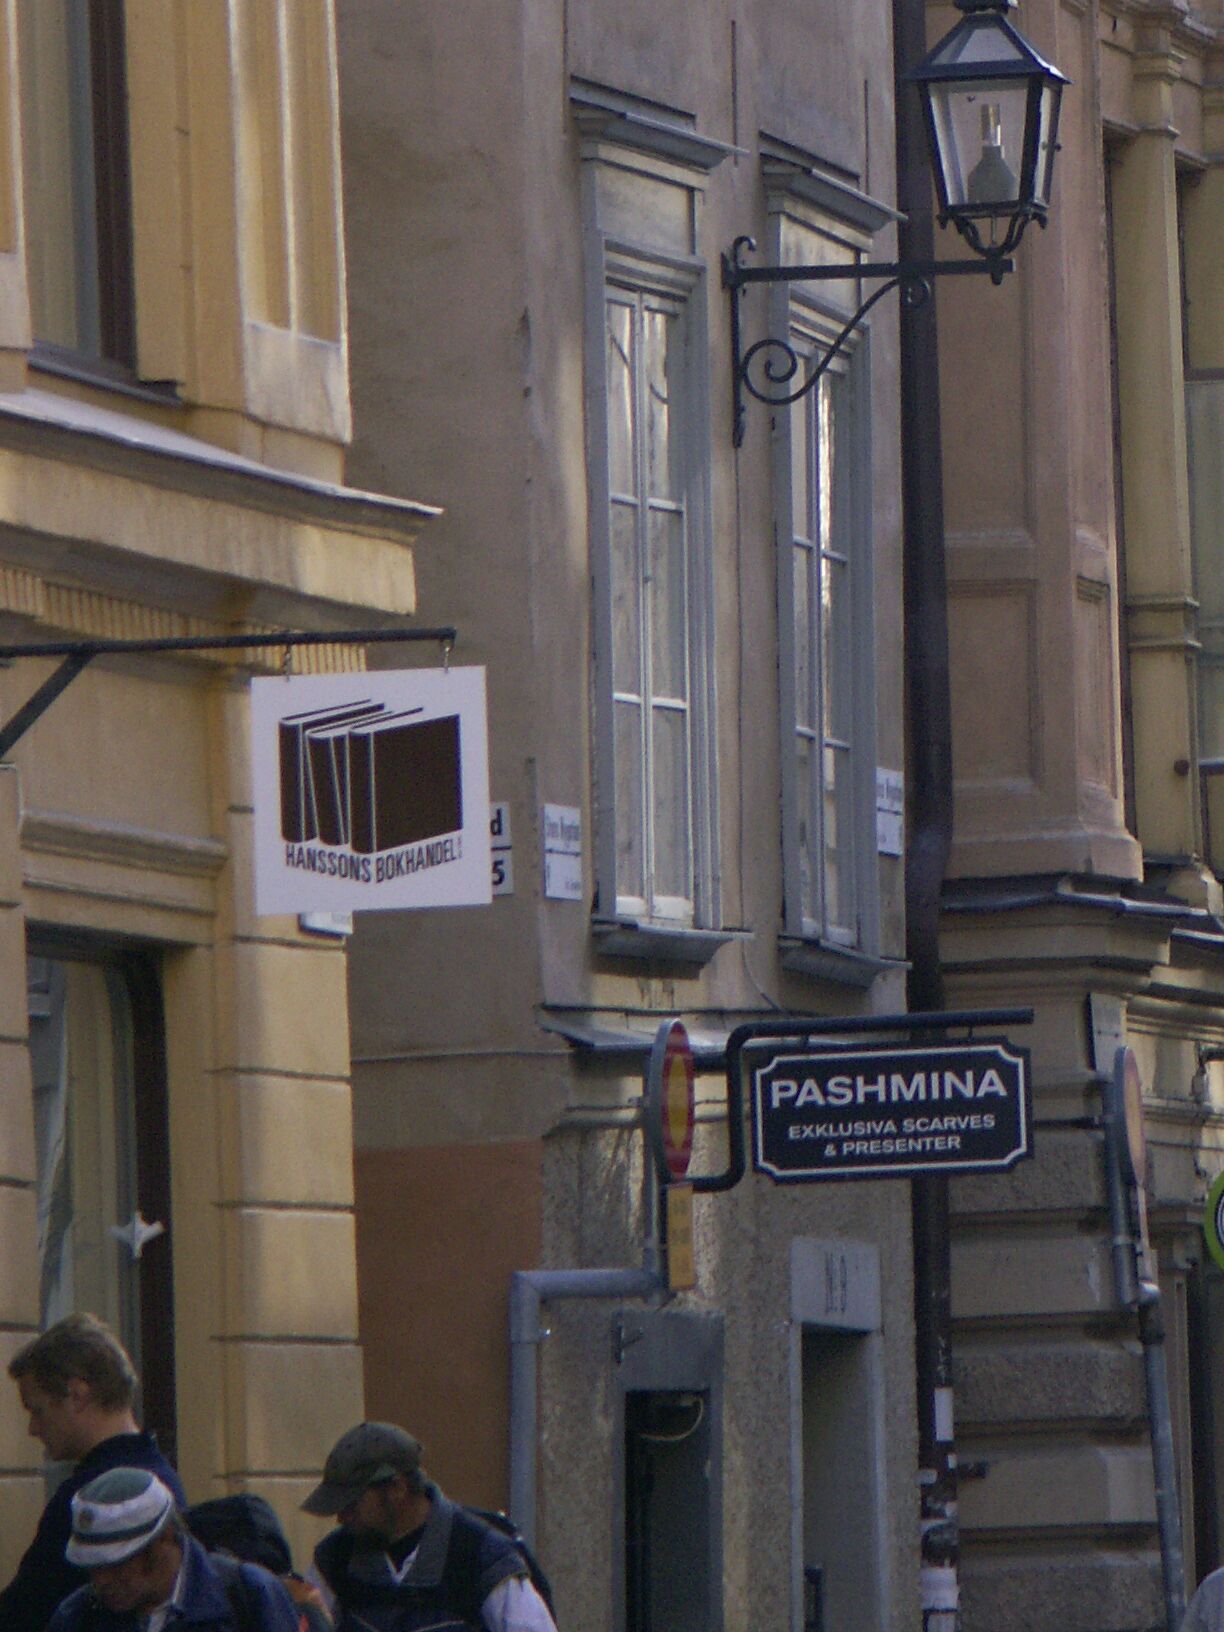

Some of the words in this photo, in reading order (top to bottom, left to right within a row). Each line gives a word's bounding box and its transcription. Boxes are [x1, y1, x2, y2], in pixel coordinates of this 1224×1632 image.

[285, 843, 371, 882] HANSSONS
[376, 838, 457, 883] BOKHANDEL
[771, 1069, 1007, 1109] PASHMINA
[788, 1120, 897, 1140] EXKLUSIVA
[902, 1114, 995, 1133] SCARVES
[824, 1144, 837, 1157] &
[842, 1135, 961, 1156] PRESENTER
